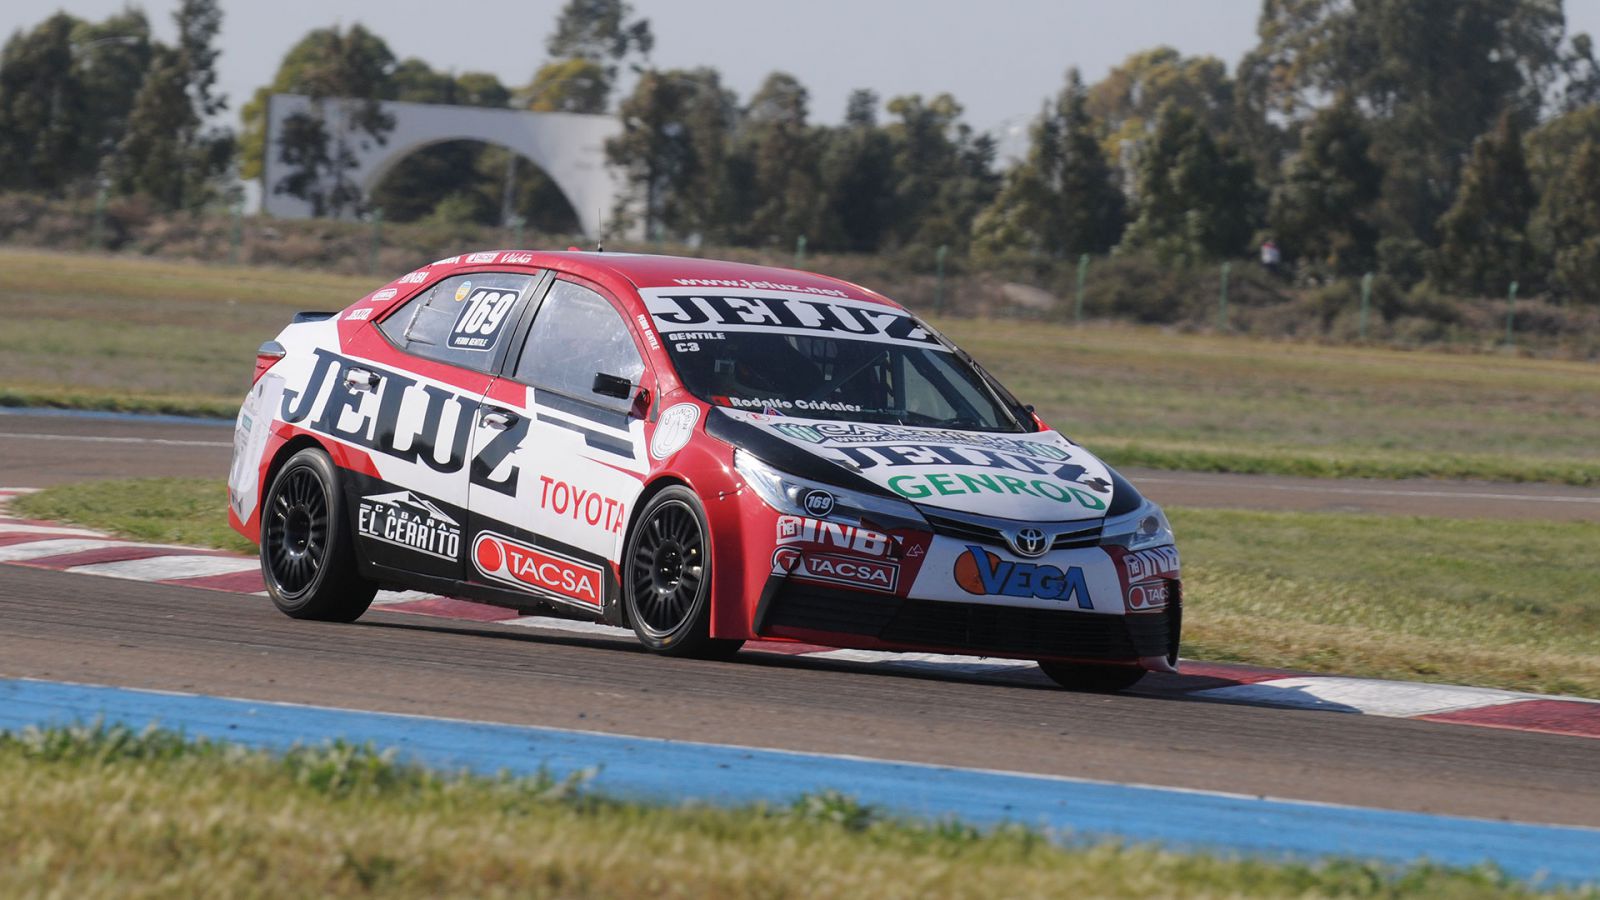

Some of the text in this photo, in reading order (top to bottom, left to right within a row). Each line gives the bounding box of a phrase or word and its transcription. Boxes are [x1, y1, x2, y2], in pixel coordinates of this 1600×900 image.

[672, 278, 848, 298] www.jeluz.net
[455, 291, 516, 335] 169
[652, 295, 942, 346] JELUZ
[668, 332, 726, 341] GENTILE
[675, 342, 700, 352] C3
[281, 347, 532, 498] JELUZ
[729, 396, 862, 413] Rodolfo Cristales
[823, 445, 1112, 493] JELUZ
[540, 474, 625, 537] TOYOTA
[807, 496, 831, 510] 169
[887, 473, 1107, 511] GENROD
[358, 508, 460, 558] EL CERRITO
[511, 551, 596, 599] TACSA
[809, 558, 888, 584] TACSA
[965, 545, 1094, 610] VEGA
